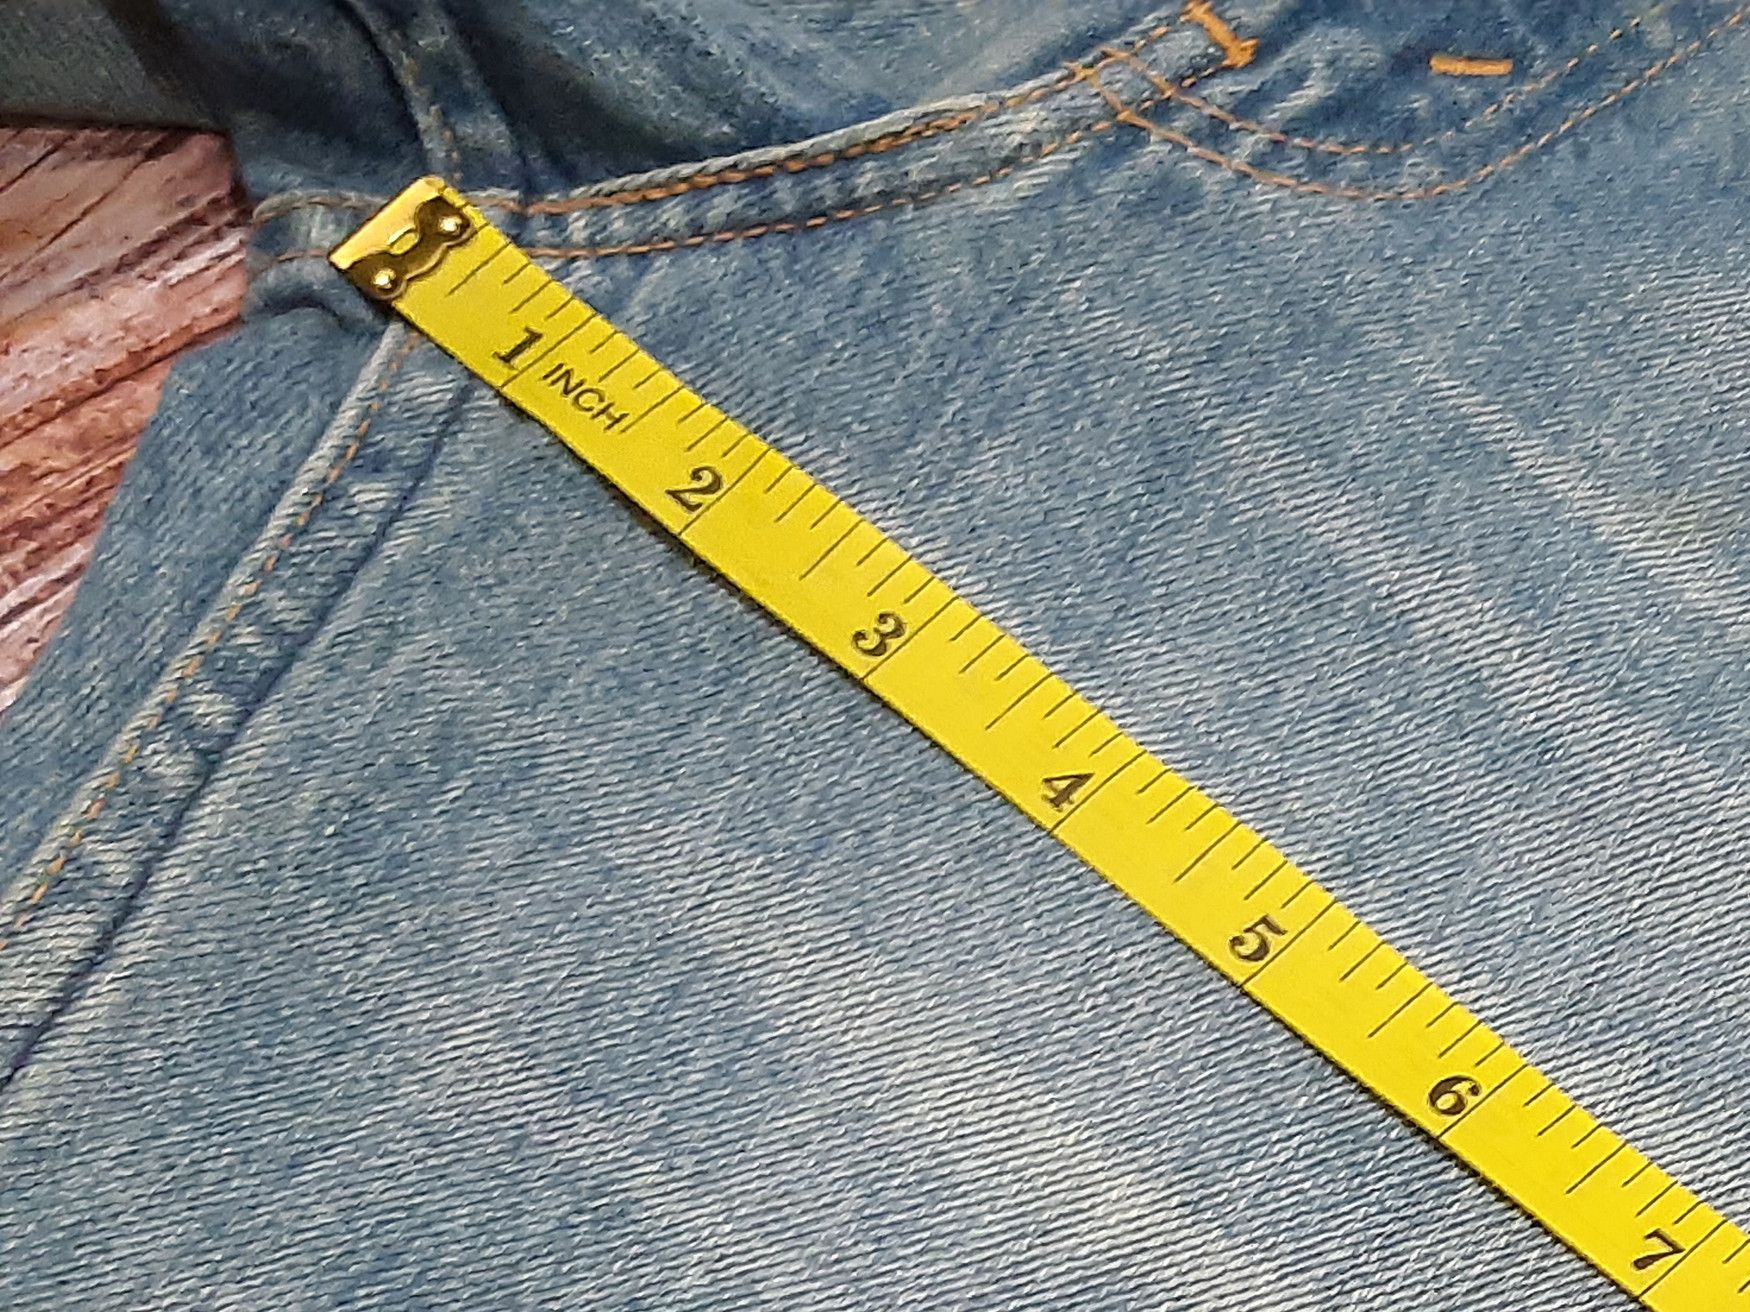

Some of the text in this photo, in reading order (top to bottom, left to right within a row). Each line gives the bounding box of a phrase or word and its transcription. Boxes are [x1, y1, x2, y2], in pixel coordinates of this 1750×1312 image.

[493, 326, 629, 433] 1 INCH
[665, 466, 723, 513] 2
[851, 612, 907, 657] 3
[1041, 770, 1095, 811] 4
[1228, 914, 1288, 962] 5
[1427, 1074, 1481, 1116] 6
[1630, 1228, 1687, 1271] 7
